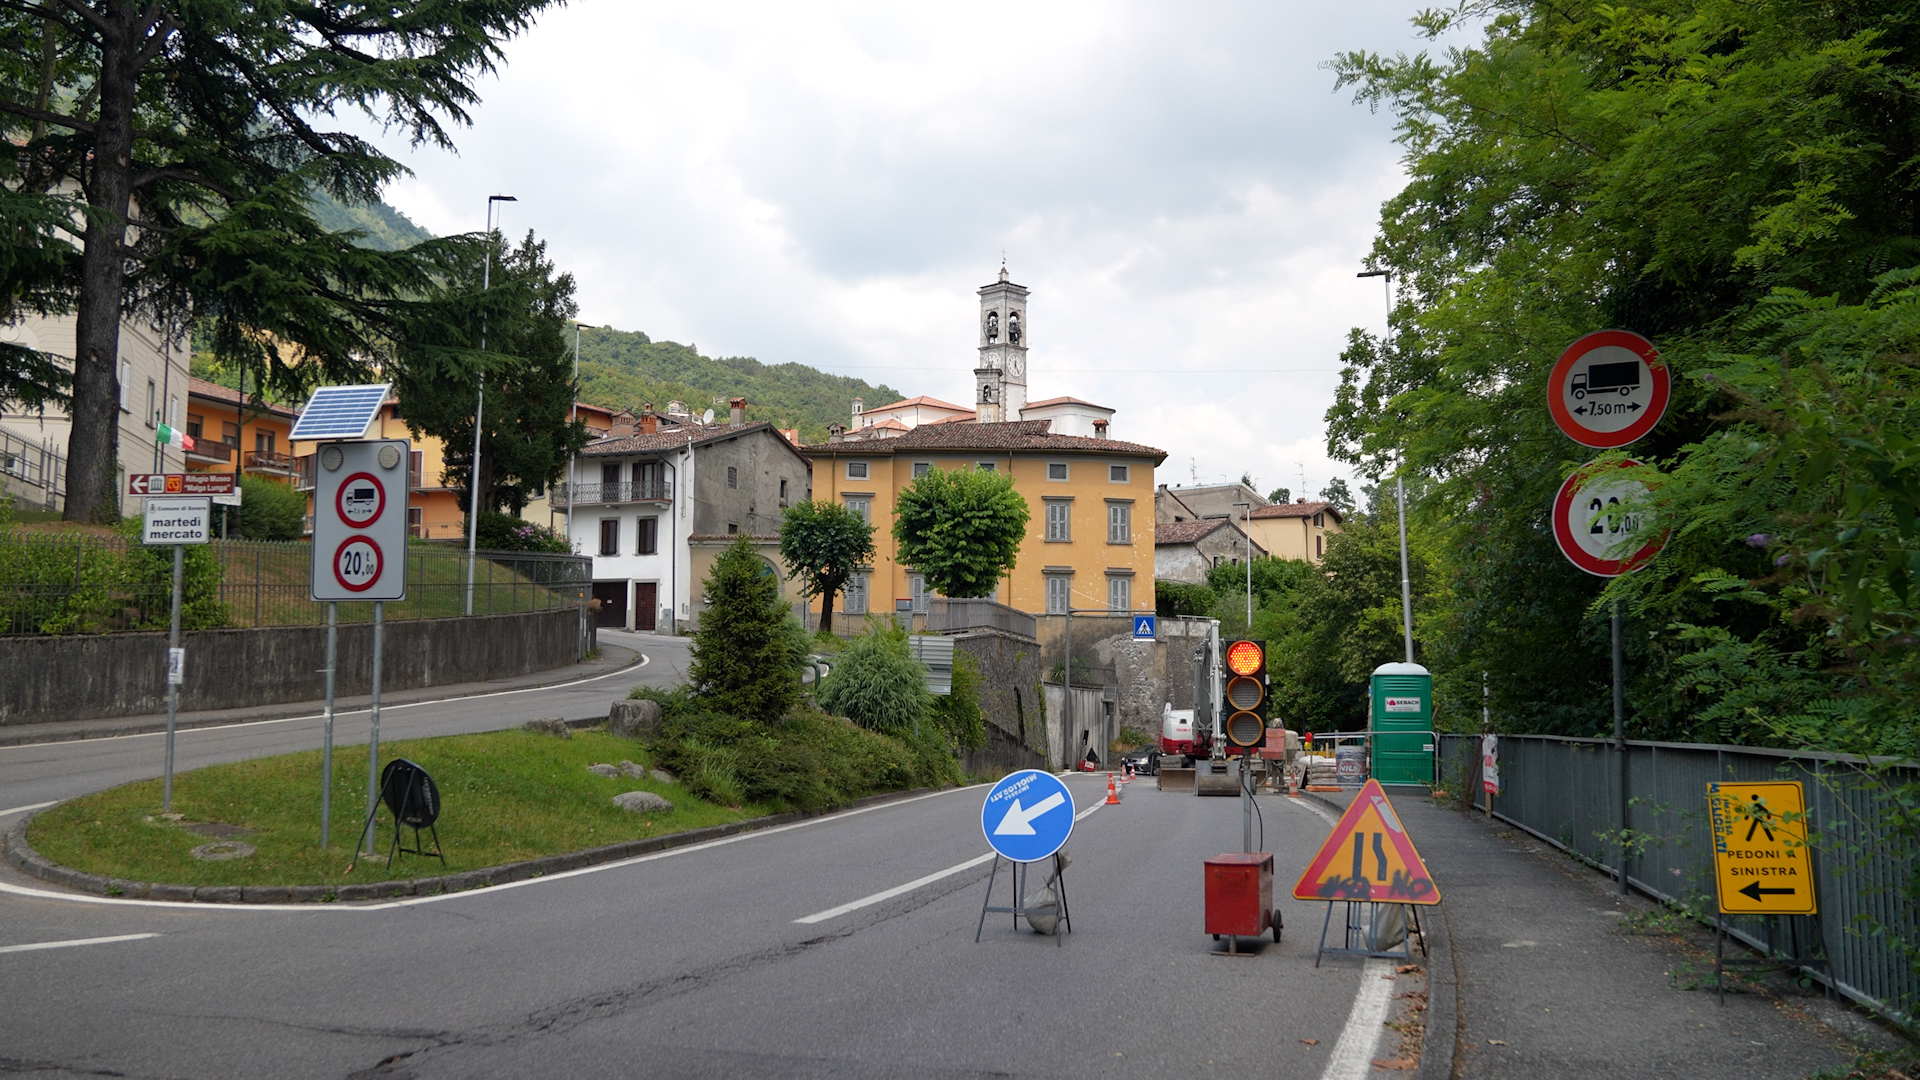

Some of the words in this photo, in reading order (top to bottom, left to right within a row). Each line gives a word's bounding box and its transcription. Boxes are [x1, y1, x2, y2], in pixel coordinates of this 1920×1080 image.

[1589, 401, 1612, 417] 7,50
[1614, 402, 1626, 414] m
[185, 475, 209, 484] Rifugio
[150, 529, 202, 539] mercato
[990, 773, 1038, 803] MIGLIORATI
[1711, 783, 1728, 853] MGLIORATI
[1727, 850, 1780, 859] PEDONI
[1731, 867, 1798, 876] SINISTRA
